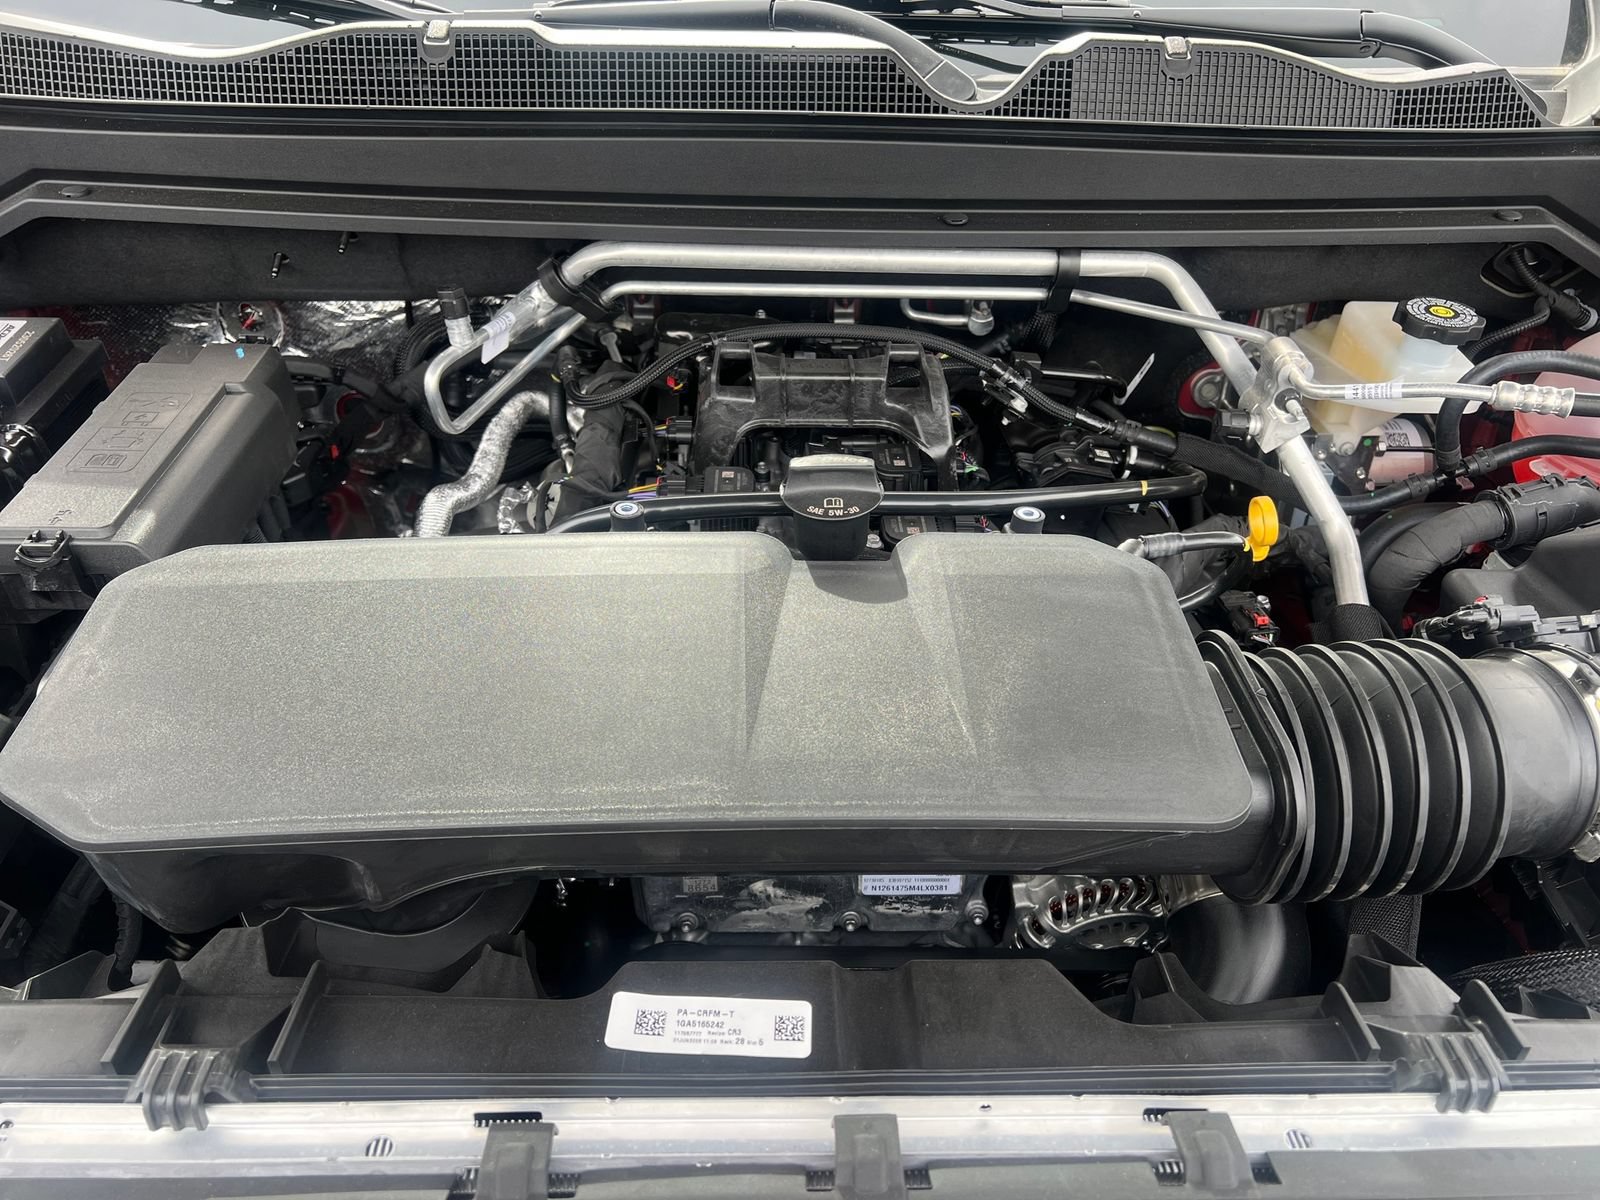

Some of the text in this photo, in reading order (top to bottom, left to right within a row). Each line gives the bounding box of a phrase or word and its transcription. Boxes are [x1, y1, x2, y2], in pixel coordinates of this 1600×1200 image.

[806, 505, 860, 517] SAE 5W-30
[735, 1037, 745, 1045] 28
